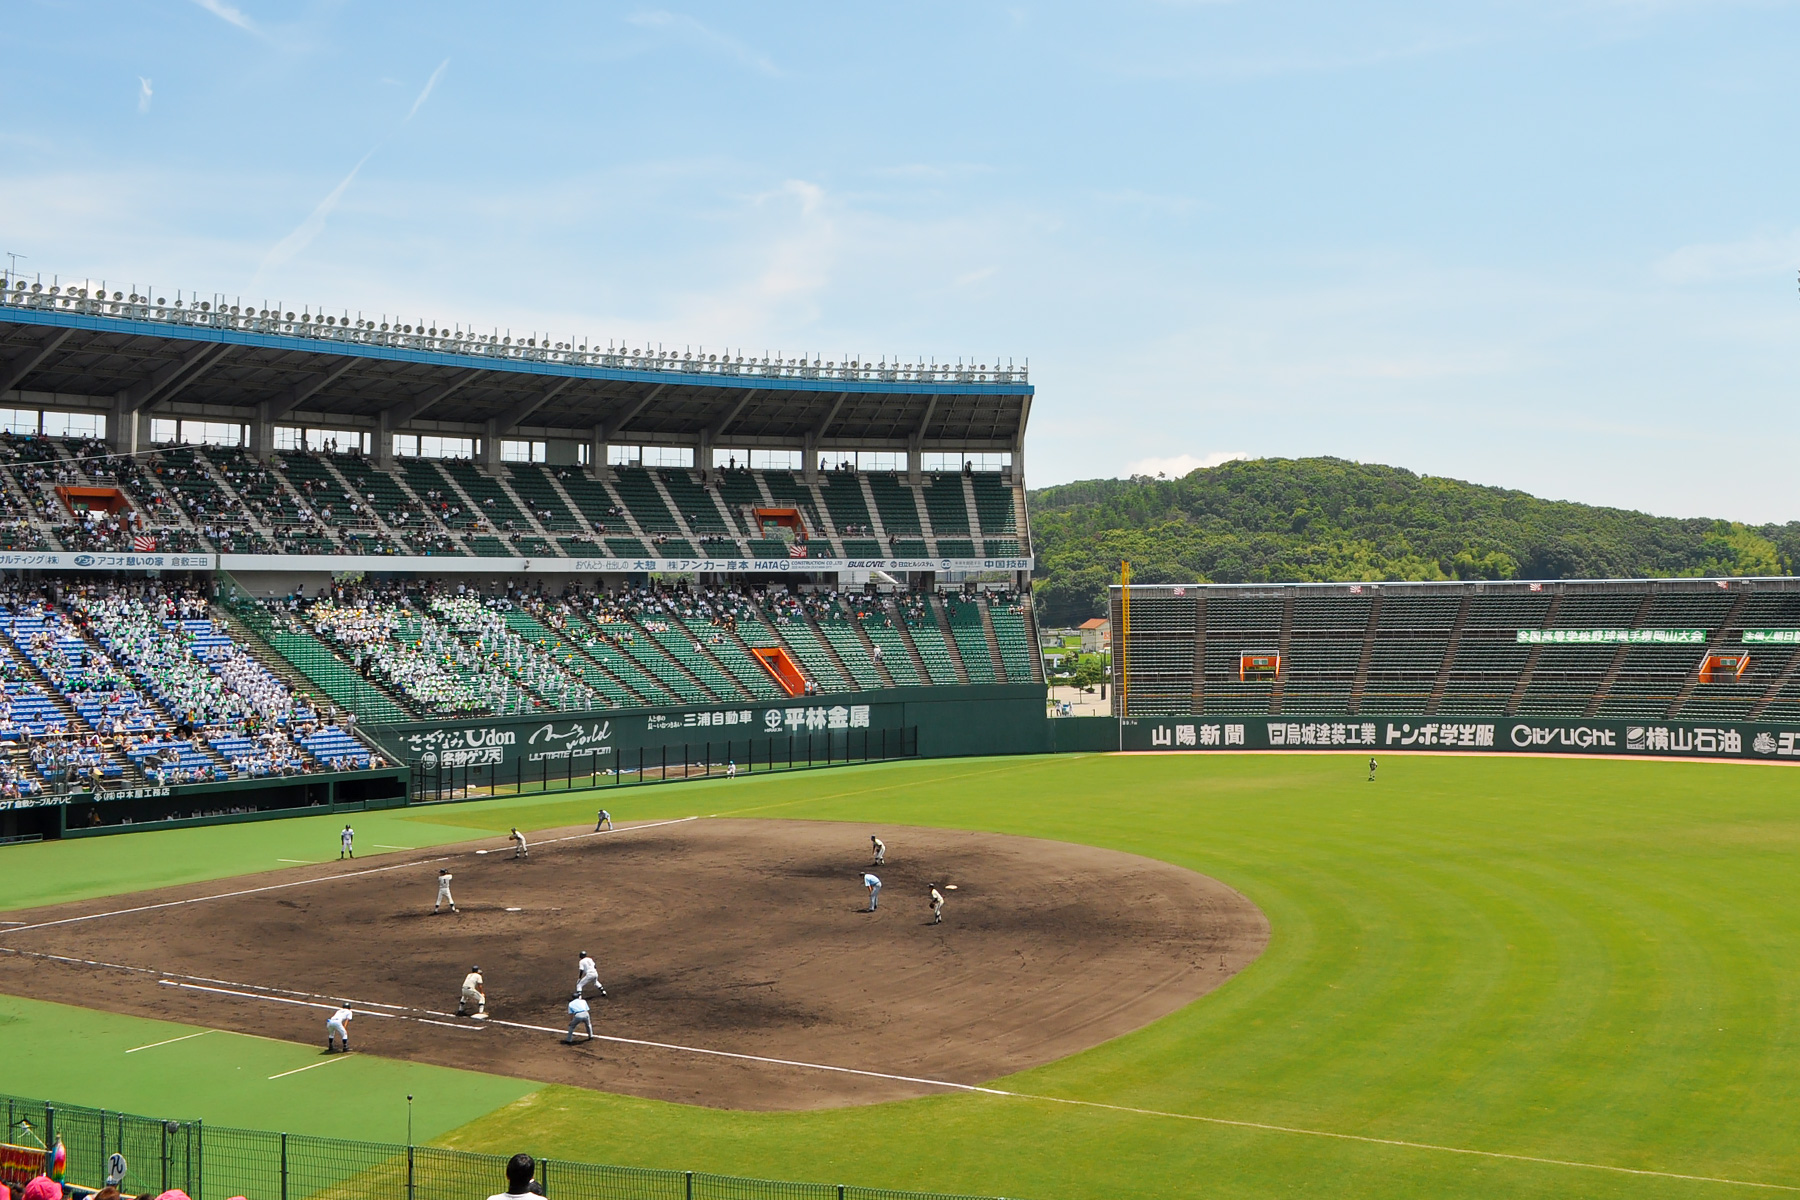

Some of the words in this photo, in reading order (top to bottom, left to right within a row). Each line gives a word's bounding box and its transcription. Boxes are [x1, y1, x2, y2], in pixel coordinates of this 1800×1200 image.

[171, 557, 208, 567] 倉敷三田
[754, 561, 779, 570] HATA
[984, 560, 1028, 569] 中国技研
[683, 710, 753, 727] 三浦自動車
[784, 705, 870, 731] 平林金属
[464, 728, 516, 747] Udon
[1151, 724, 1245, 746] 山陽新聞
[1385, 723, 1495, 746] トンボ学生服
[1646, 726, 1742, 753] 横山石油
